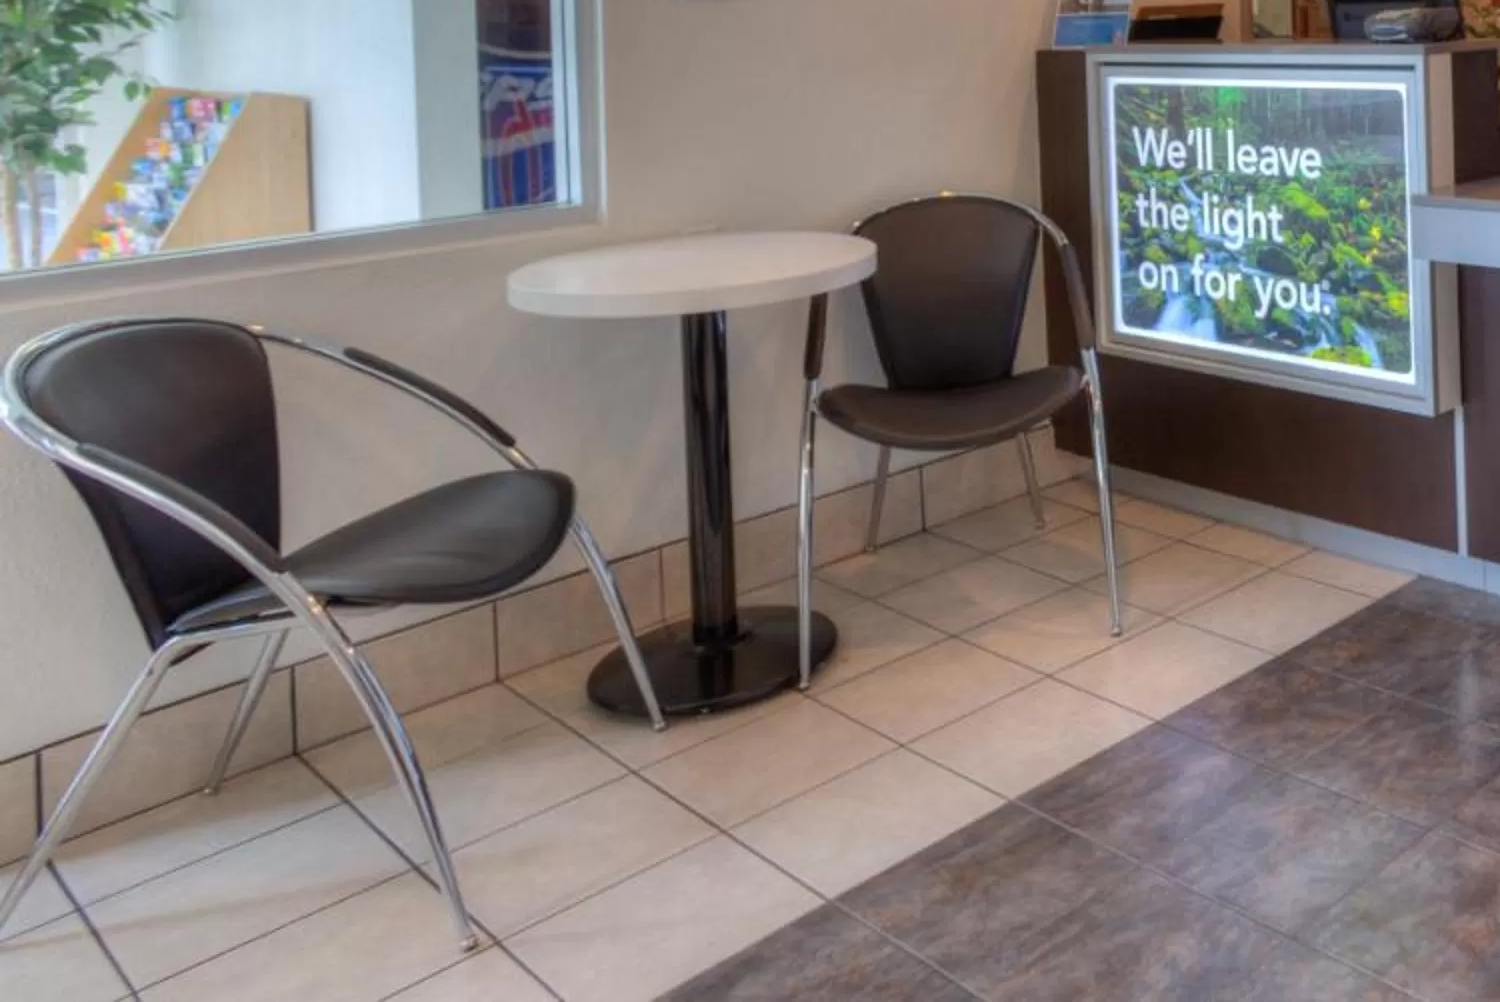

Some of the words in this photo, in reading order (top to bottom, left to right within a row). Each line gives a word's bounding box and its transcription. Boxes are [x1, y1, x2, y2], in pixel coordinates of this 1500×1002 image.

[1132, 125, 1213, 171] We'll
[1226, 128, 1322, 179] leave
[1136, 187, 1190, 232] the
[1203, 191, 1284, 249] light
[1138, 261, 1179, 295] on
[1191, 253, 1241, 302] for
